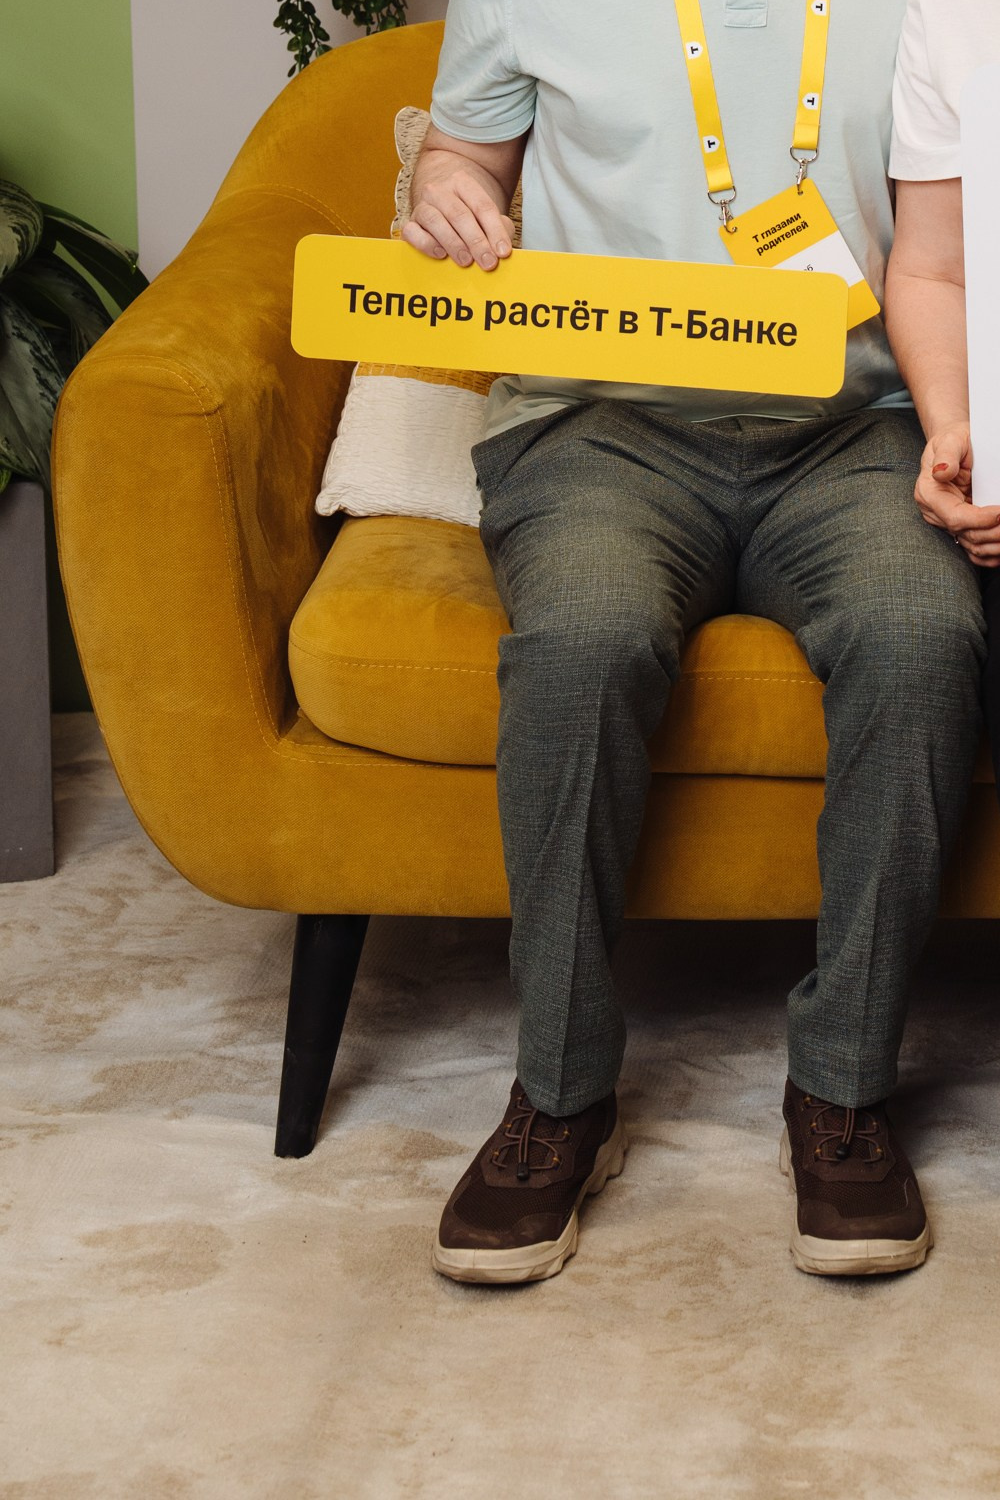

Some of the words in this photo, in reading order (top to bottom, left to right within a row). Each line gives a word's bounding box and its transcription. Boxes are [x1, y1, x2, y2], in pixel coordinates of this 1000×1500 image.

[756, 220, 809, 257] родителей
[760, 212, 802, 240] глазами
[342, 283, 474, 327] Теперь
[484, 299, 609, 332] растёт
[618, 311, 639, 334] в
[649, 306, 798, 347] Т-Банке
